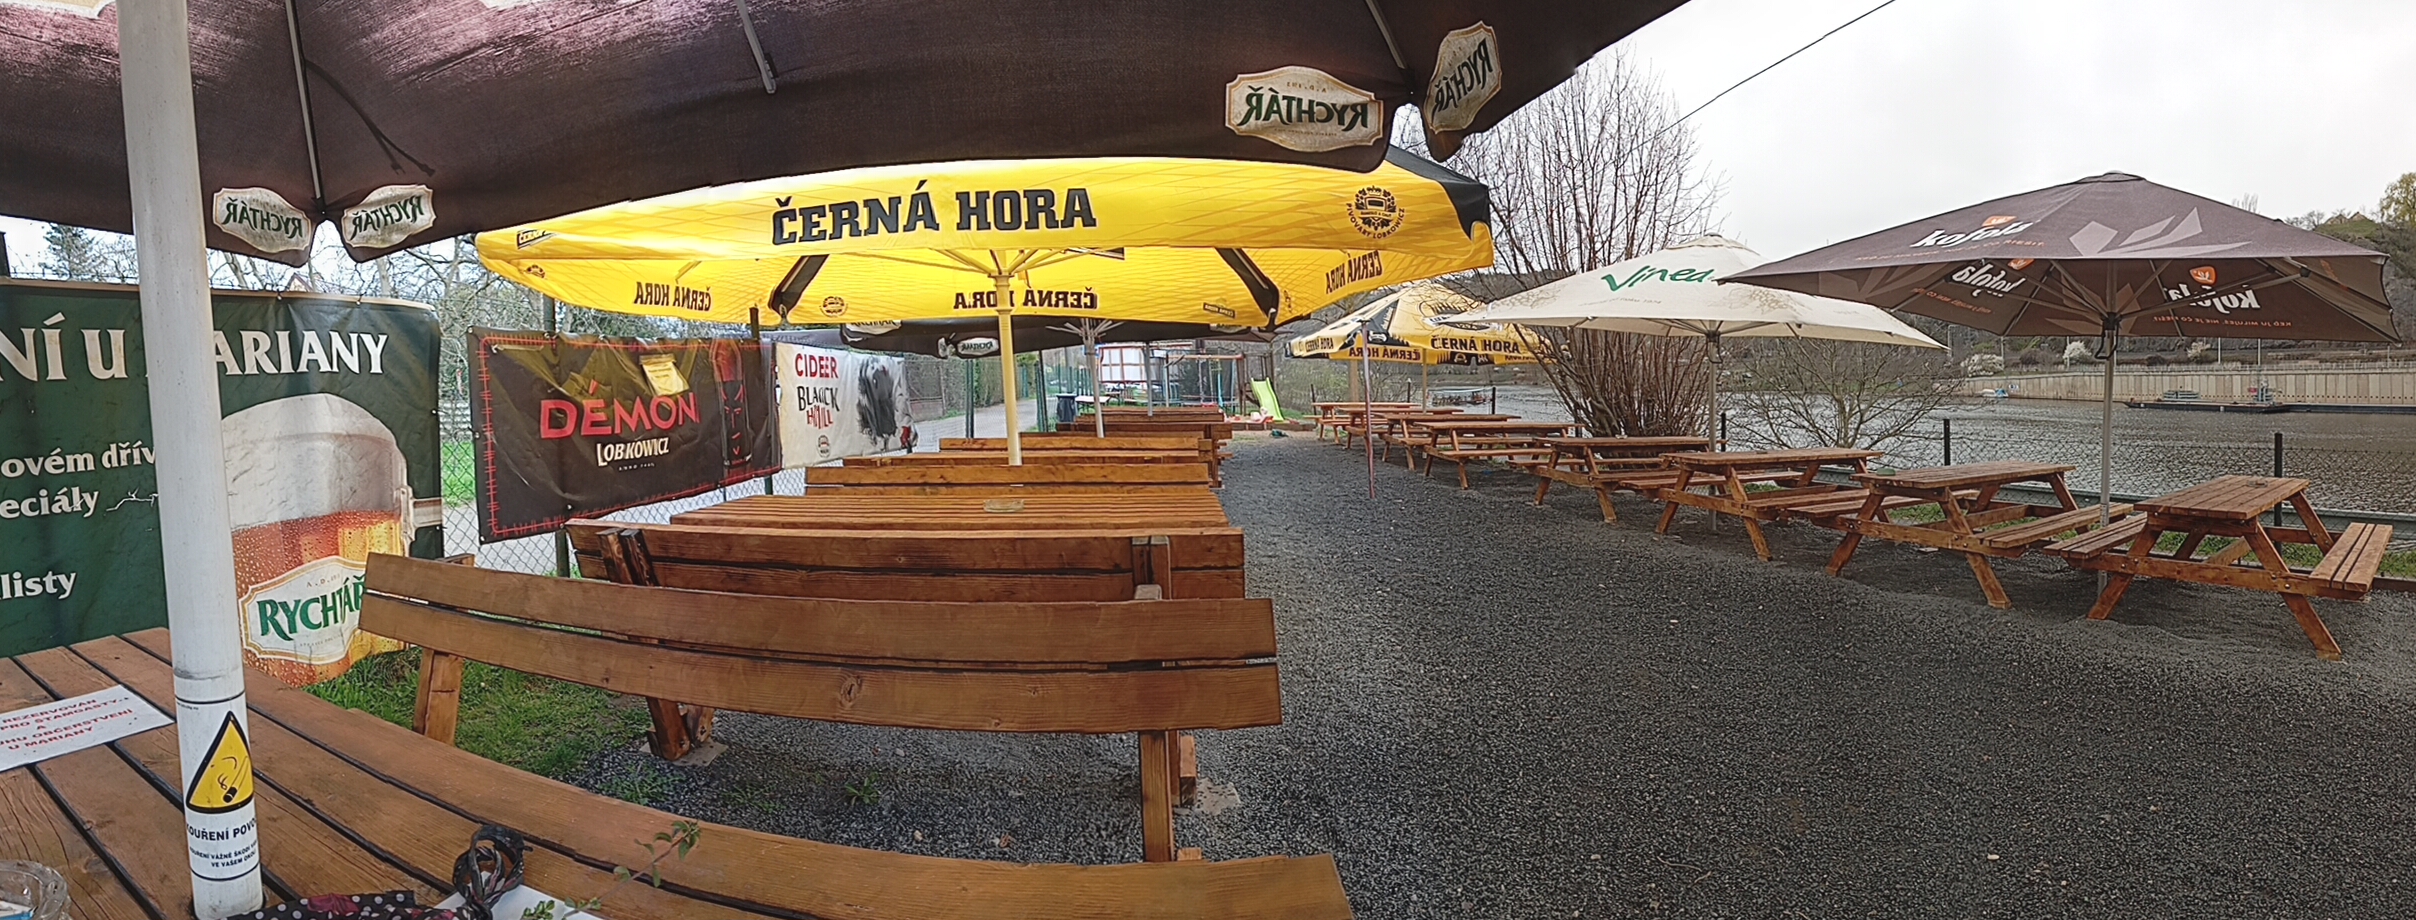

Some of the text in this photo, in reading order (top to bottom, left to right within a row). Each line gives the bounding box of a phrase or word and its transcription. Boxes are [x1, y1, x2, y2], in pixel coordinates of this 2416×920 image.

[772, 179, 1097, 245] ČERNÁ HORA
[213, 331, 389, 377] ARIANY
[1484, 339, 1521, 353] HORA
[540, 379, 701, 439] DÉMON
[596, 437, 670, 467] LOBKOWICZ
